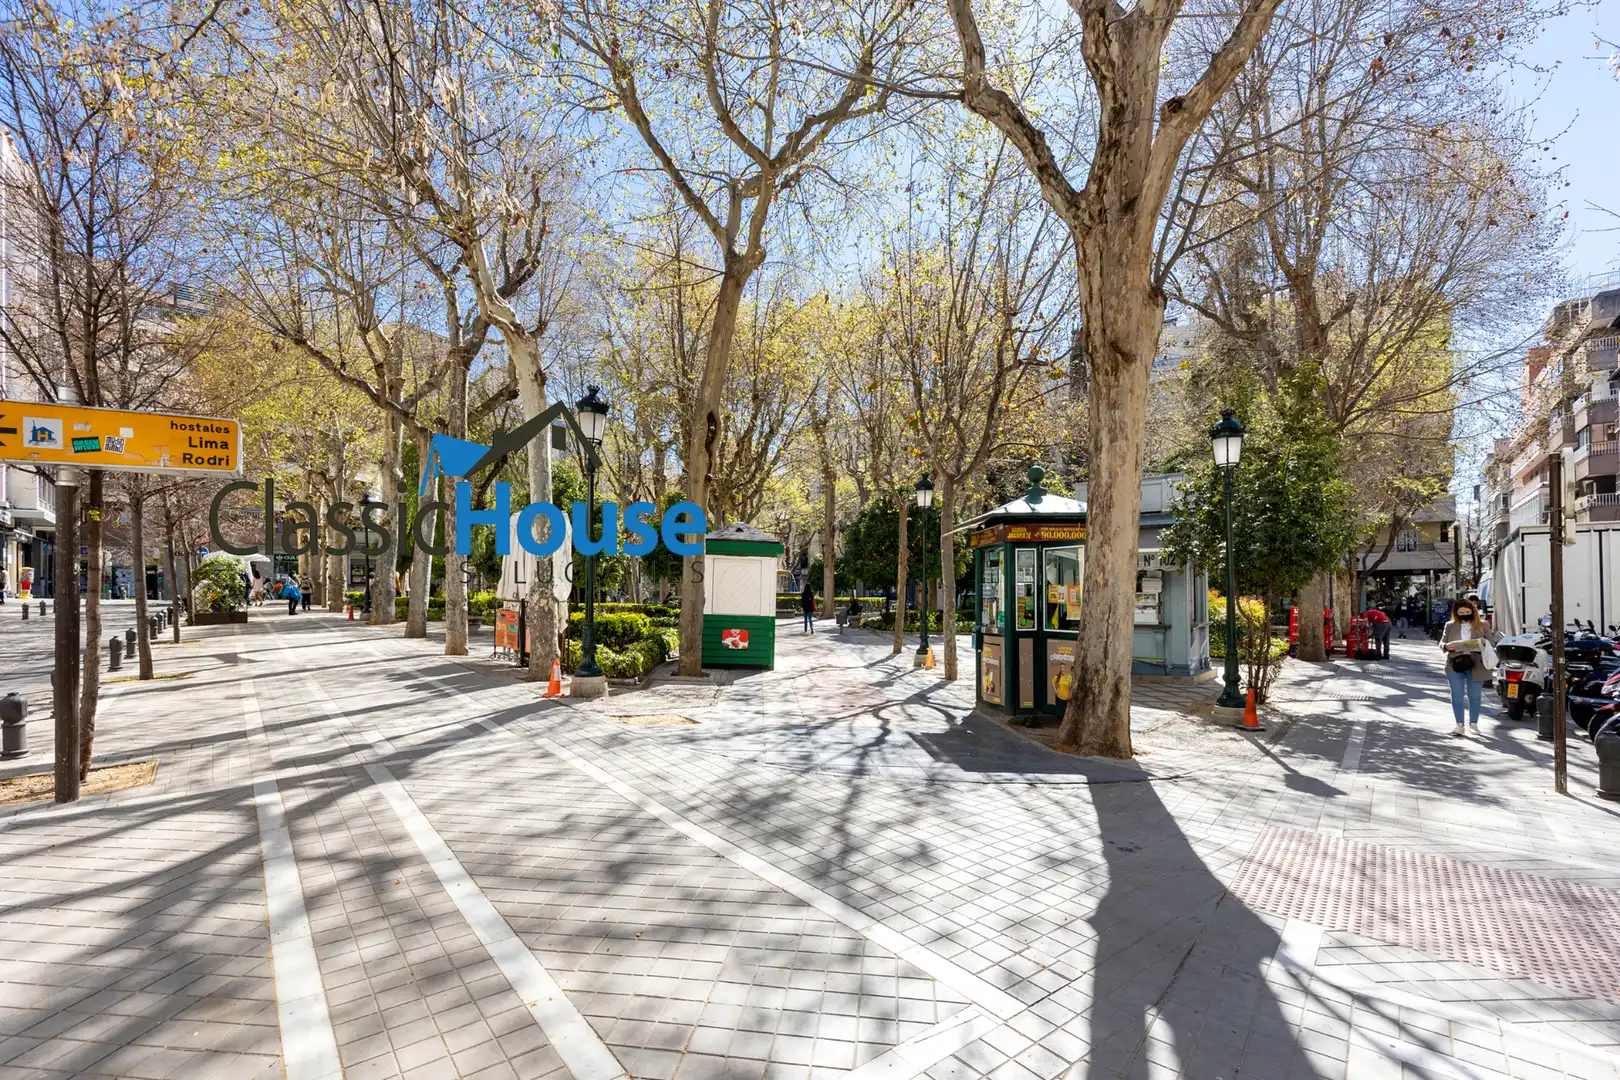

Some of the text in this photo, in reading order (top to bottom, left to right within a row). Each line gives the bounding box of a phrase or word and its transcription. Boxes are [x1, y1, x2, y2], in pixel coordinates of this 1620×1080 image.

[170, 420, 231, 434] hostales
[188, 436, 229, 450] Lima
[182, 452, 230, 467] Rodri
